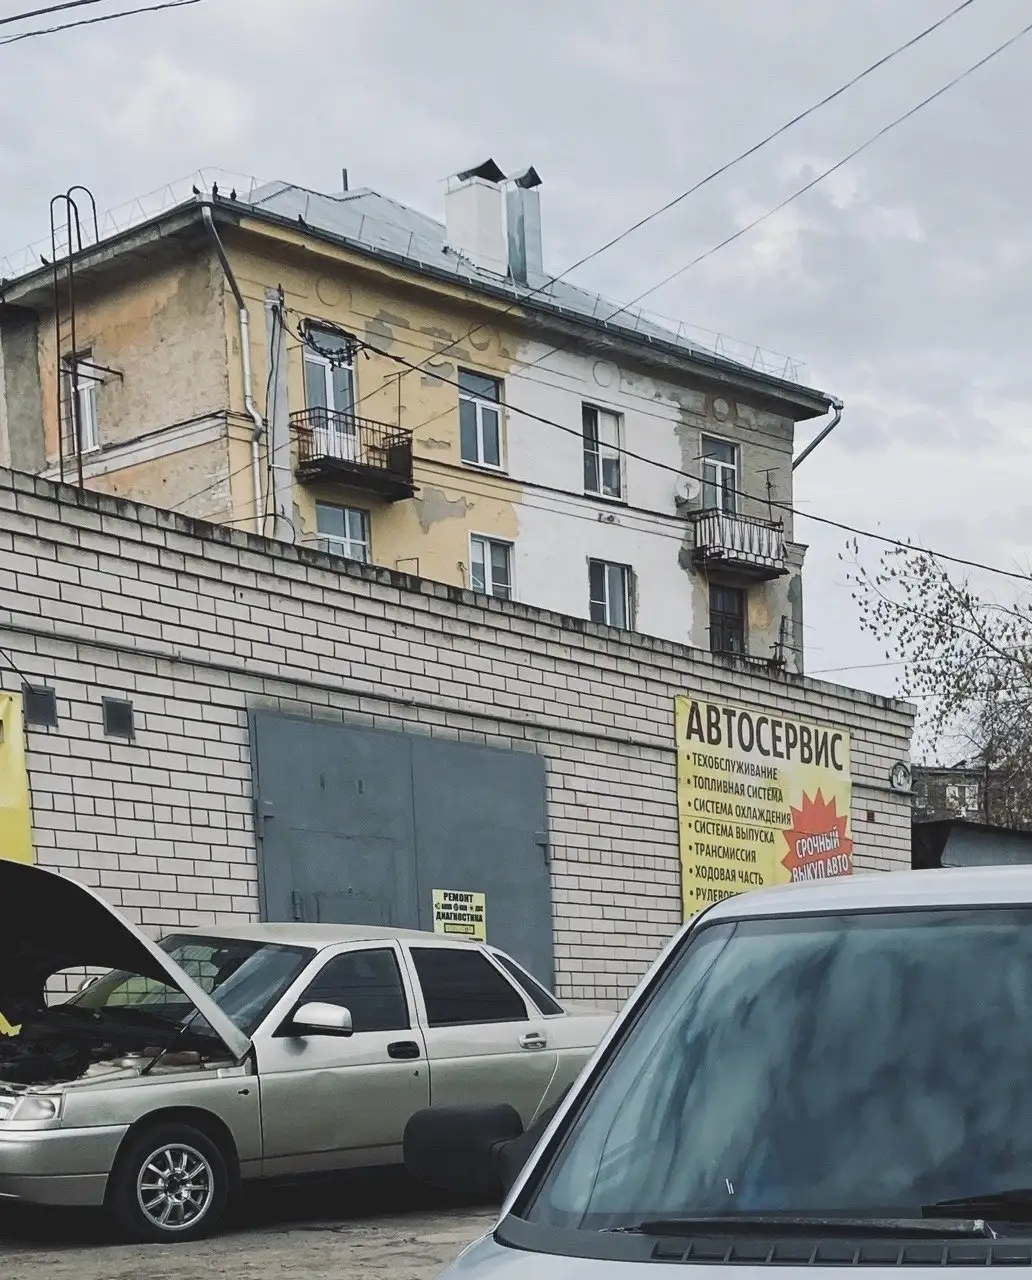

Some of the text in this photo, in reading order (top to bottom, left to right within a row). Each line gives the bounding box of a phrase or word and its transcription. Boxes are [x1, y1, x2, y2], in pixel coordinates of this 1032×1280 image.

[686, 701, 843, 771] АВТОСЕРВИС
[692, 752, 778, 780] ТЕХОБСЛУЖИВАНИЕ
[693, 775, 783, 803] ТОПЛИВНАЯ СИСТЕМА
[694, 798, 792, 825] СИСТЕМА ОХЛАЖДЕНИЯ
[694, 820, 775, 844] СИСТЕМА ВЫПУСКА
[796, 825, 840, 859] СРОЧНЫЙ
[695, 842, 756, 863] ТРАНСМИССИЯ
[695, 865, 764, 886] ХОДОВАЯ ЧАСТЬ
[792, 853, 849, 882] ВЫКУП АВТО
[444, 892, 473, 903] РЕМОНТ
[436, 911, 483, 922] ДИАГНОСТИКА
